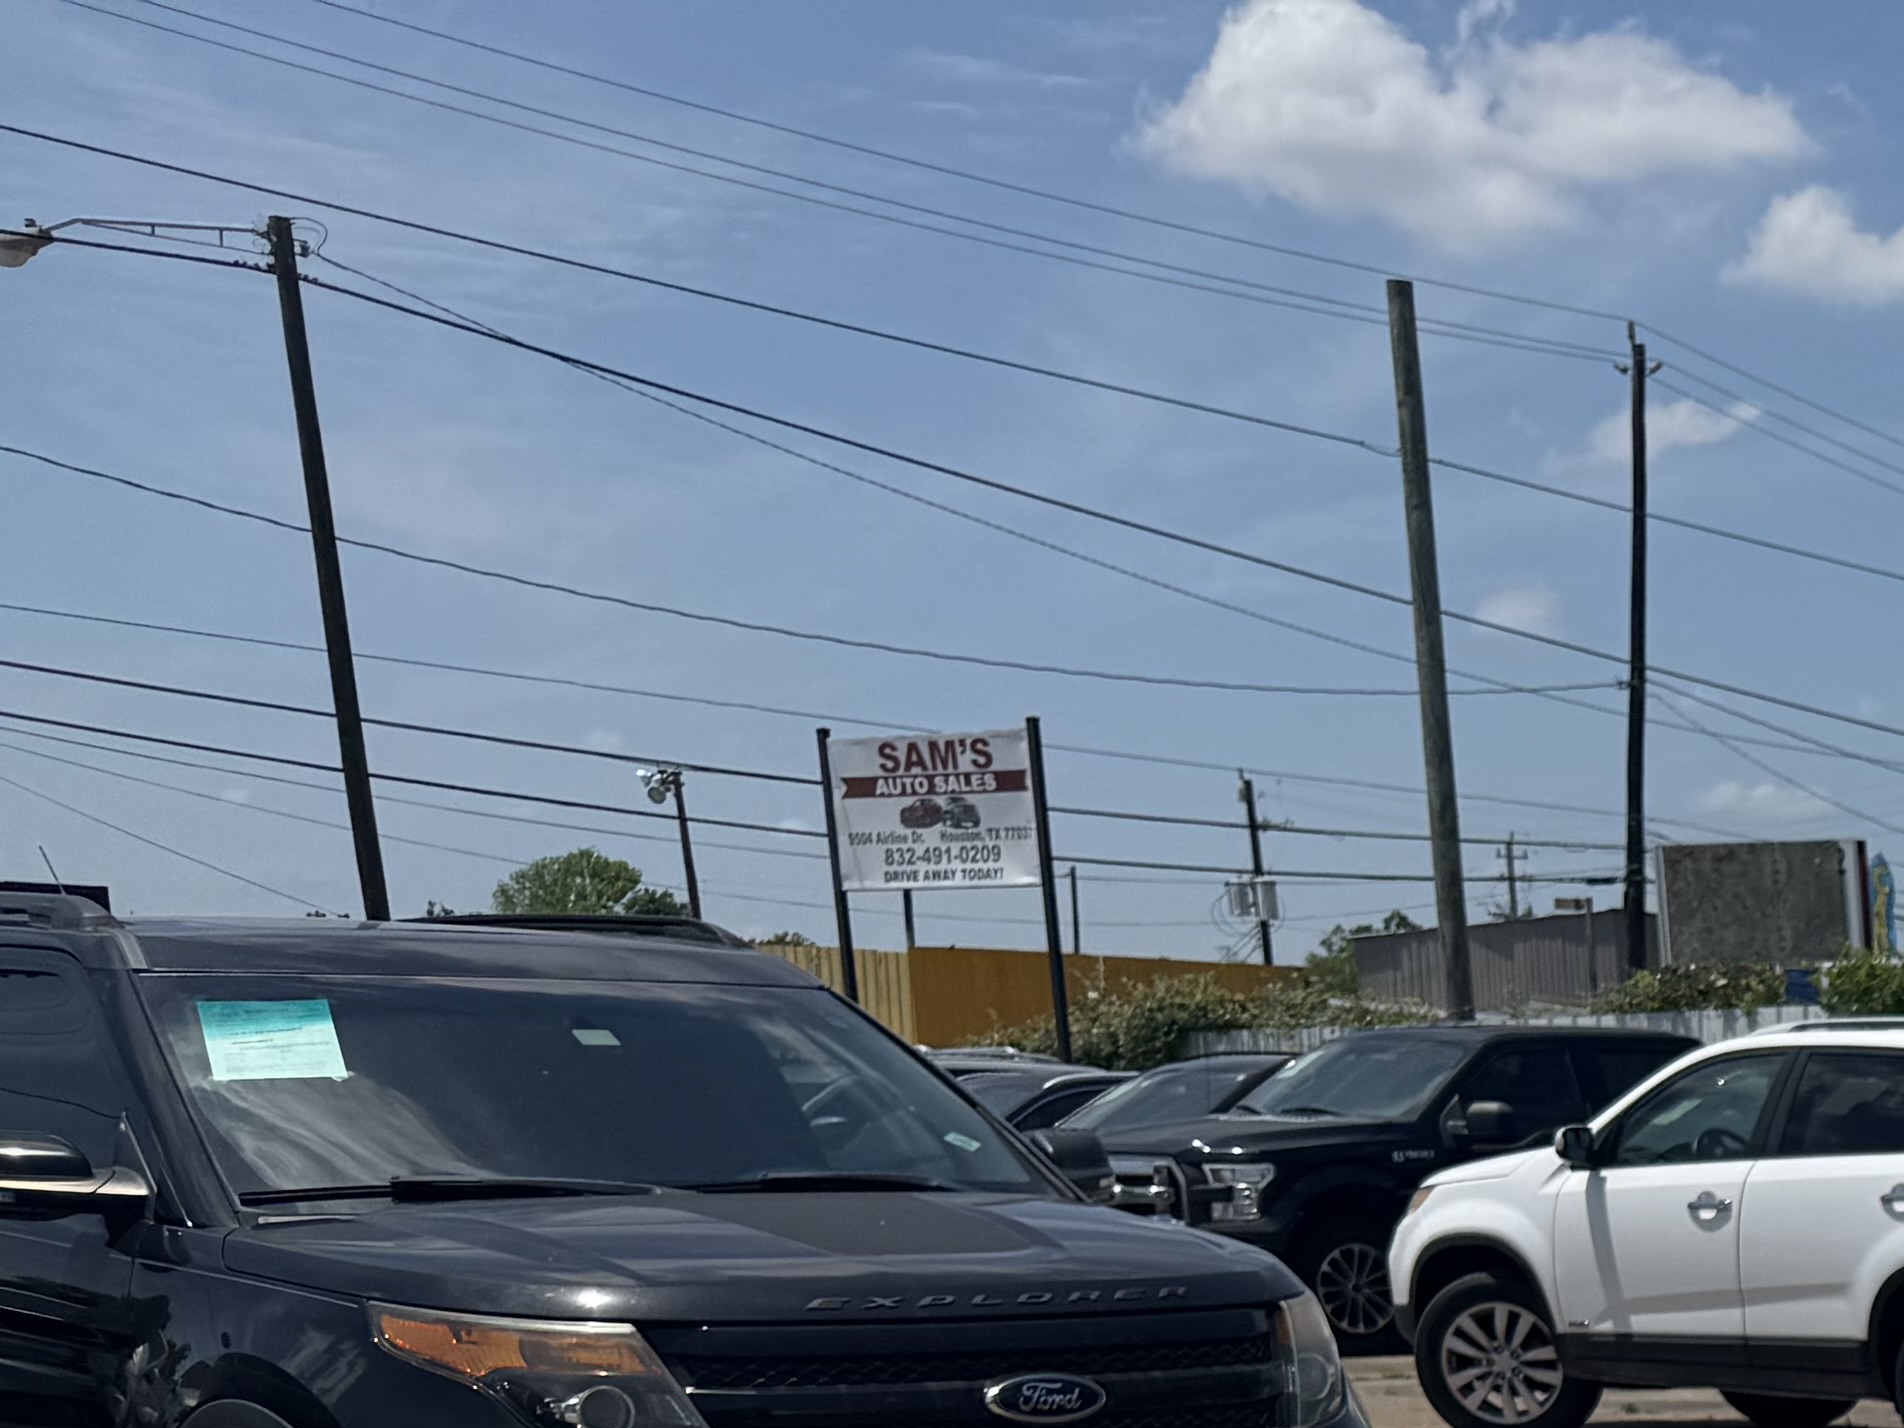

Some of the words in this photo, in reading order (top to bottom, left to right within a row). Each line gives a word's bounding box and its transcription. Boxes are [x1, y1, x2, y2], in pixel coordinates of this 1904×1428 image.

[878, 738, 993, 773] SAM'S
[875, 777, 928, 796] AUTO
[934, 773, 997, 793] SALES
[885, 844, 1001, 866] 832-491-0209
[884, 869, 920, 883] DRIVE
[922, 868, 957, 882] AWAY
[960, 866, 1004, 881] TODAY!
[803, 1285, 1188, 1311] EXPLORER
[1018, 1382, 1083, 1411] Ford
